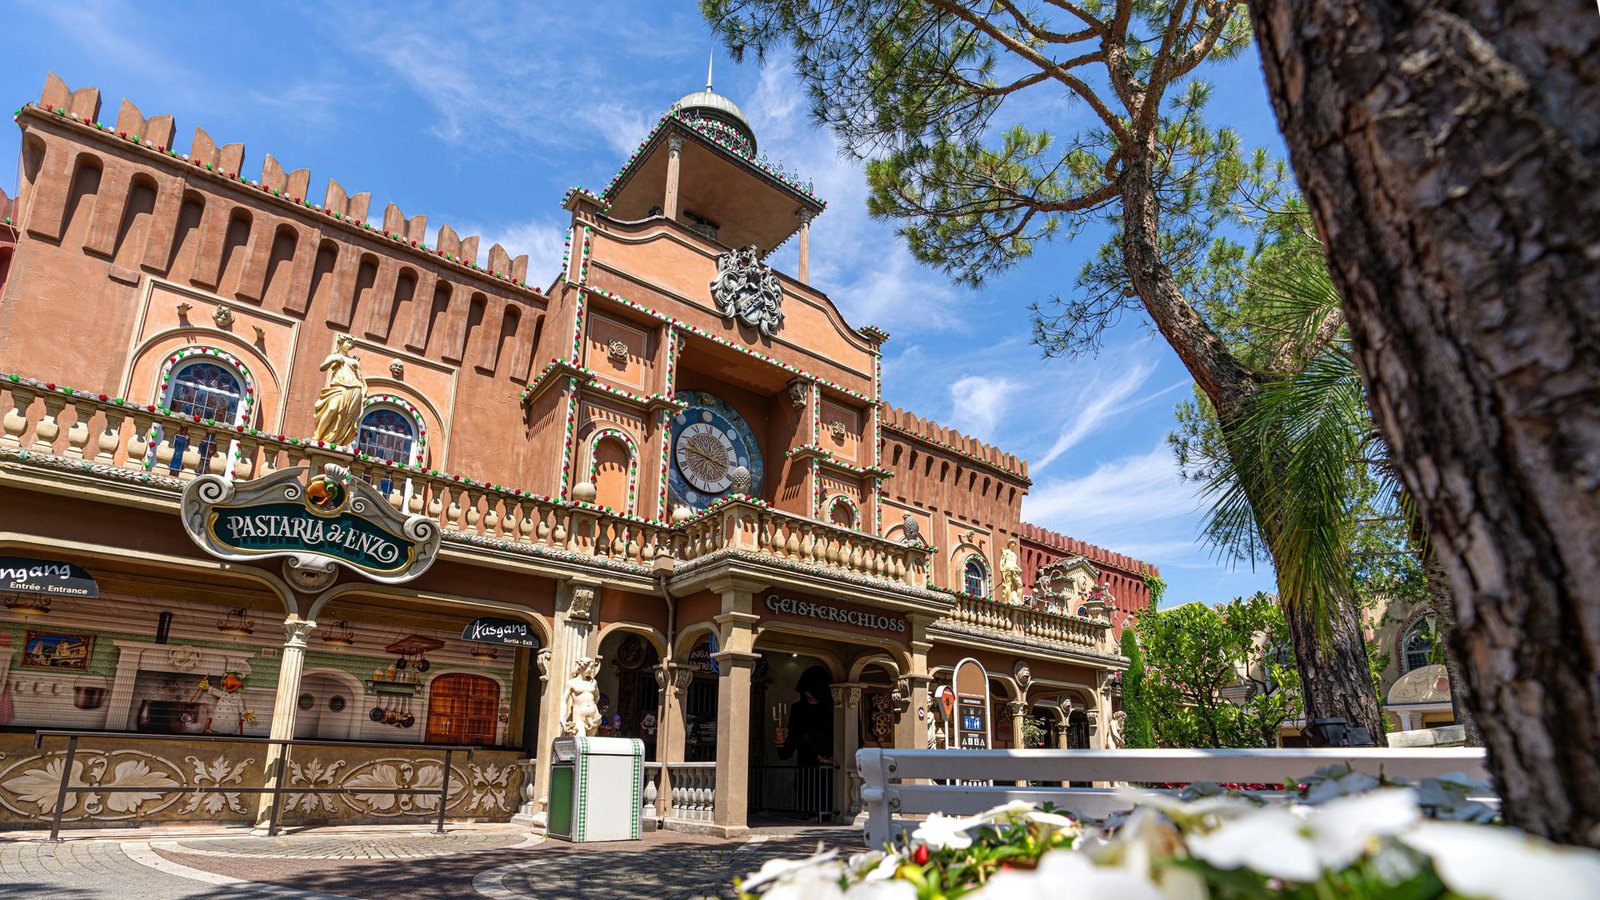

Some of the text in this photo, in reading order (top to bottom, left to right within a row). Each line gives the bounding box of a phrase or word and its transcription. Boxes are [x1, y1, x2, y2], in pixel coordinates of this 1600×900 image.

[227, 514, 399, 563] PASTARIA di ENZO
[10, 581, 88, 595] Entrée Entrance
[766, 595, 905, 632] GEISTERSCHLOSS
[472, 620, 527, 640] Ausgang
